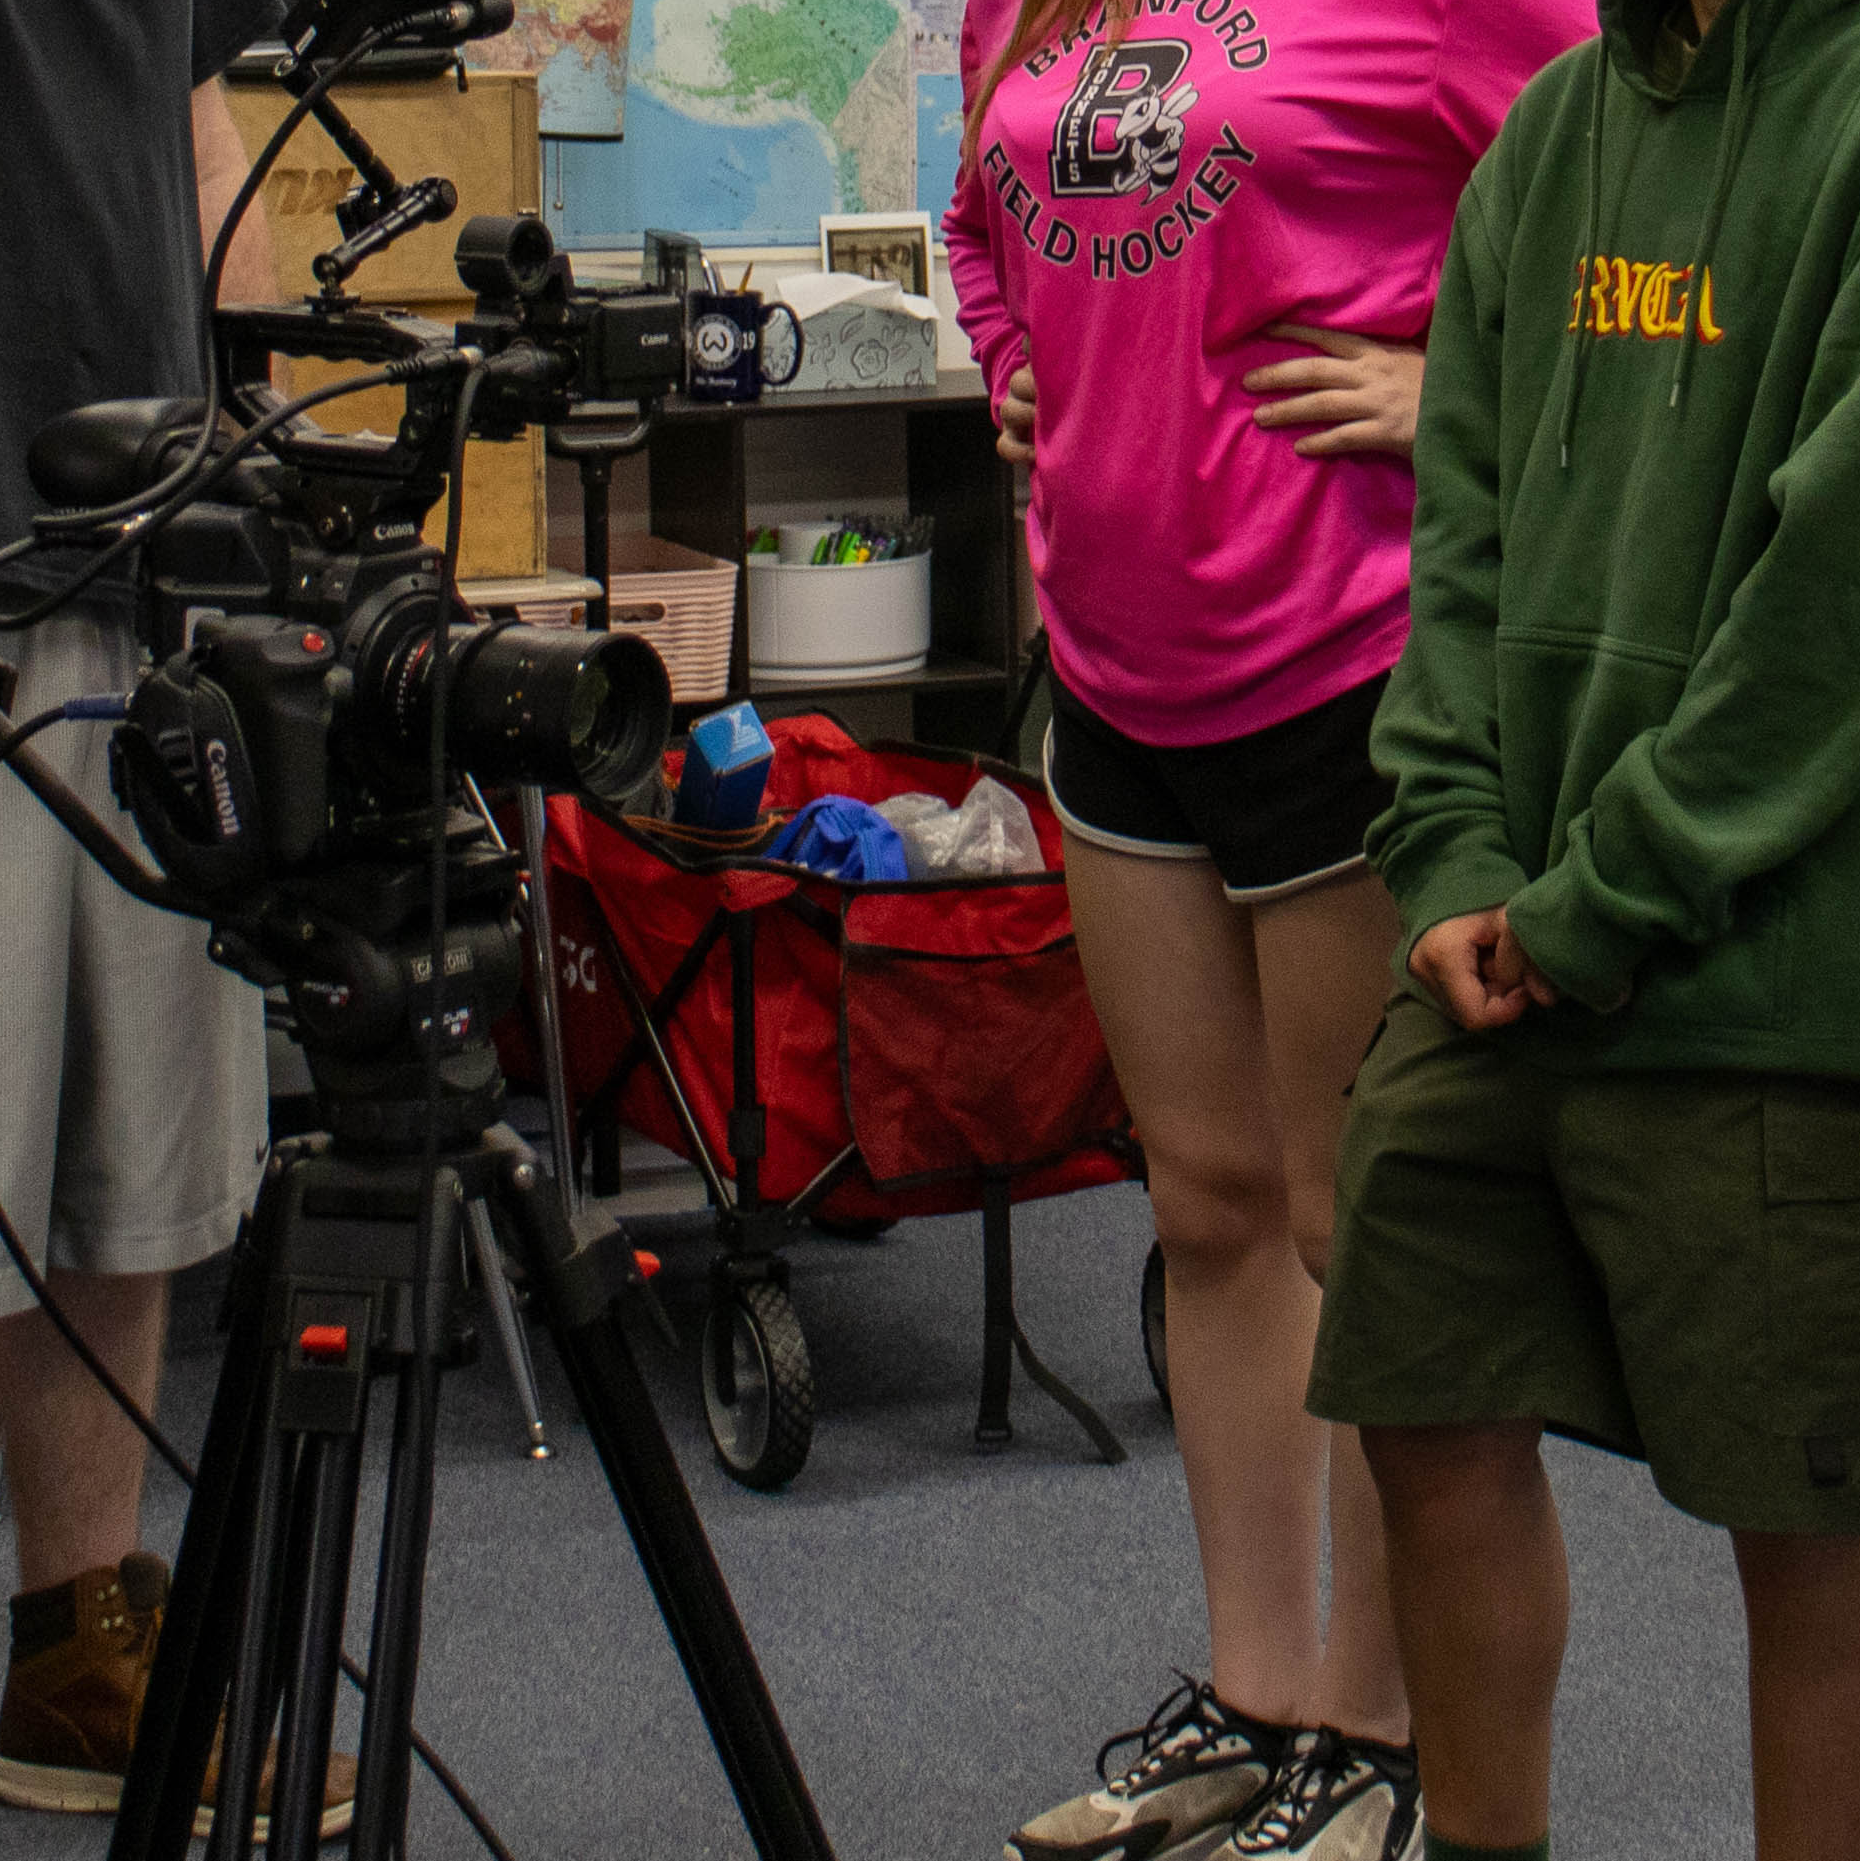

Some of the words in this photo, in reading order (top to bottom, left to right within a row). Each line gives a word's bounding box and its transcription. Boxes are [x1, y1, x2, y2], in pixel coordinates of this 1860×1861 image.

[983, 139, 1077, 265] FIELD
[1092, 120, 1257, 279] HOCKEY
[373, 522, 415, 540] Canon
[206, 739, 240, 835] Canon
